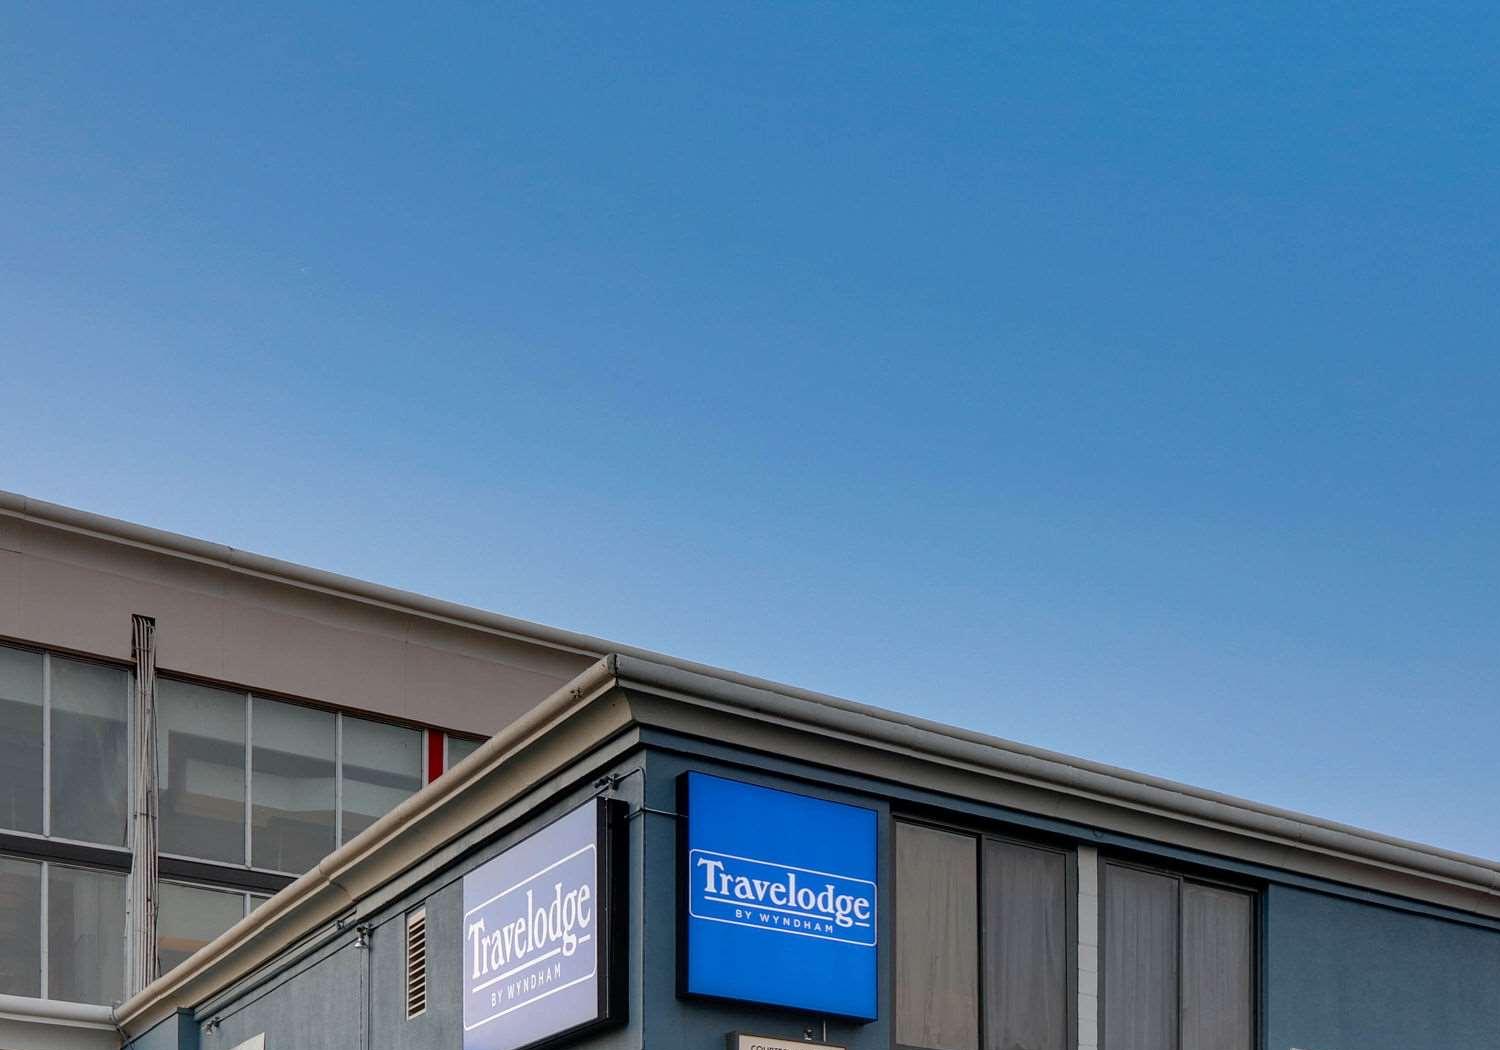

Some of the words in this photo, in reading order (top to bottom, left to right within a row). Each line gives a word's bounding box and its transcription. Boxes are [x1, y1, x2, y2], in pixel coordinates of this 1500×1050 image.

[697, 857, 870, 927] Travelodge
[735, 909, 752, 920] BY
[759, 913, 833, 933] WYNDHAM
[467, 882, 591, 979] Travelodge
[490, 991, 504, 1008] BY
[507, 962, 561, 999] WYNDHAM
